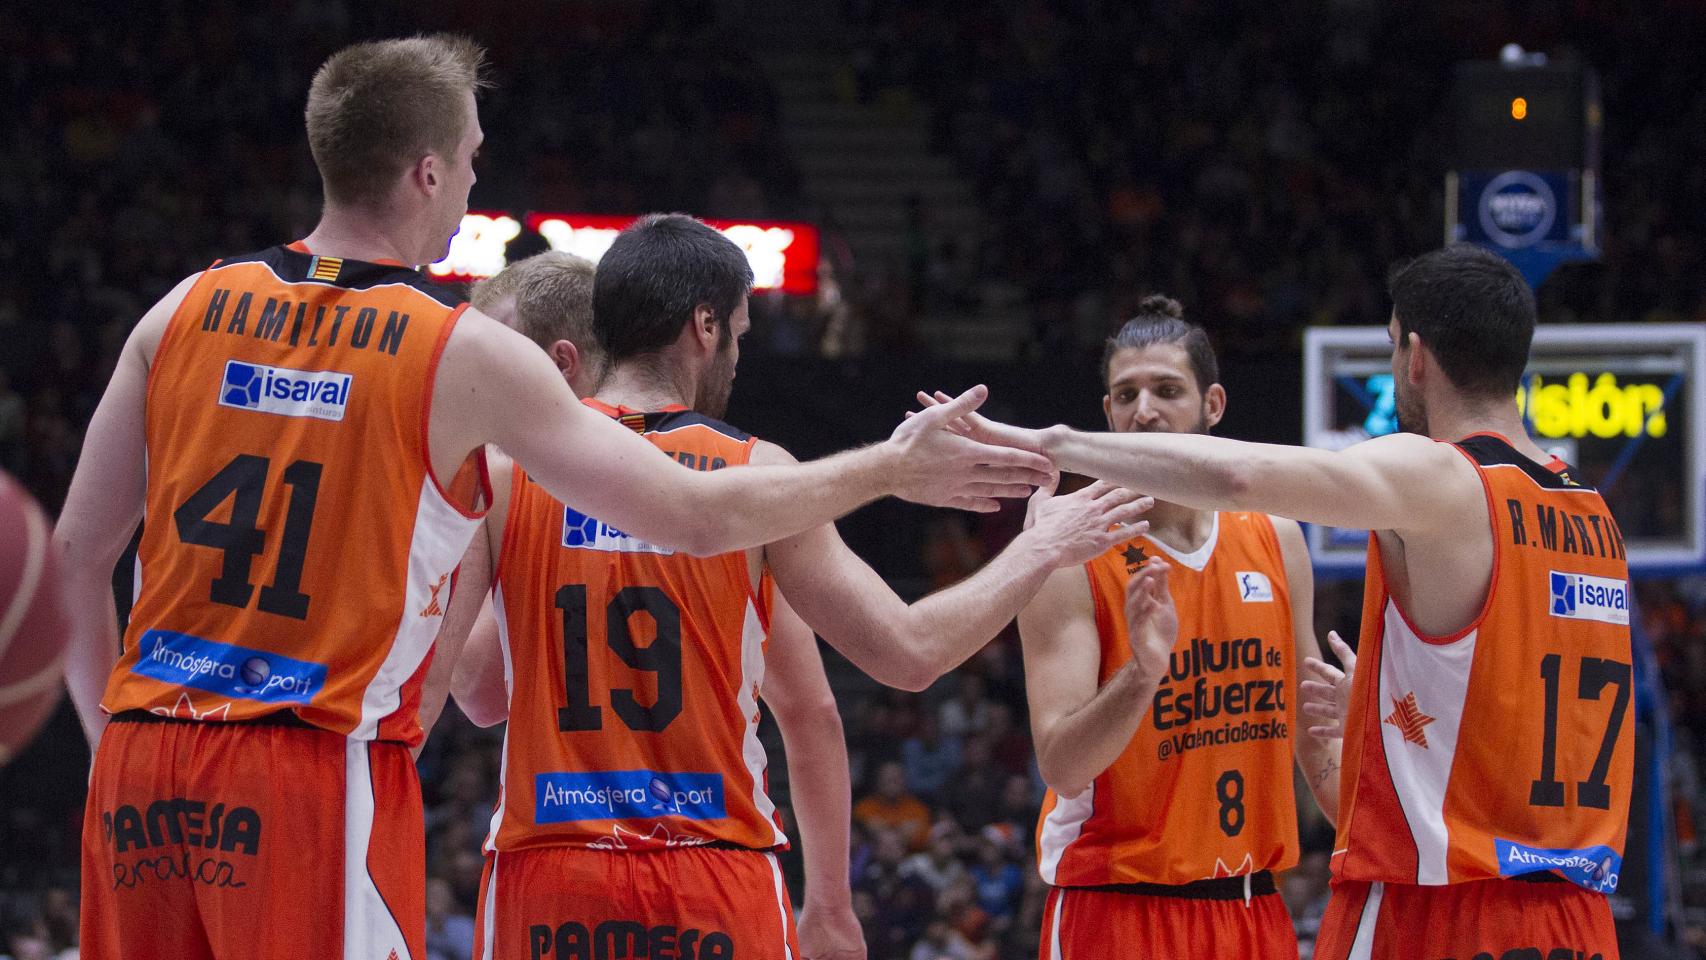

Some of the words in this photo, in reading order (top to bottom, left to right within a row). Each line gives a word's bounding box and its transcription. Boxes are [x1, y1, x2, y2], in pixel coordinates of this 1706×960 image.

[202, 289, 410, 356] HAMILTON
[264, 369, 350, 406] isaval
[174, 453, 324, 621] 41
[1578, 576, 1629, 610] isaval
[150, 636, 235, 680] Atmósfera
[555, 583, 683, 732] 19
[1159, 637, 1263, 685] ultura
[1528, 653, 1632, 810] 17
[543, 780, 646, 813] Atmósfera
[1216, 769, 1245, 837] 8
[529, 920, 735, 960] PAMESA
